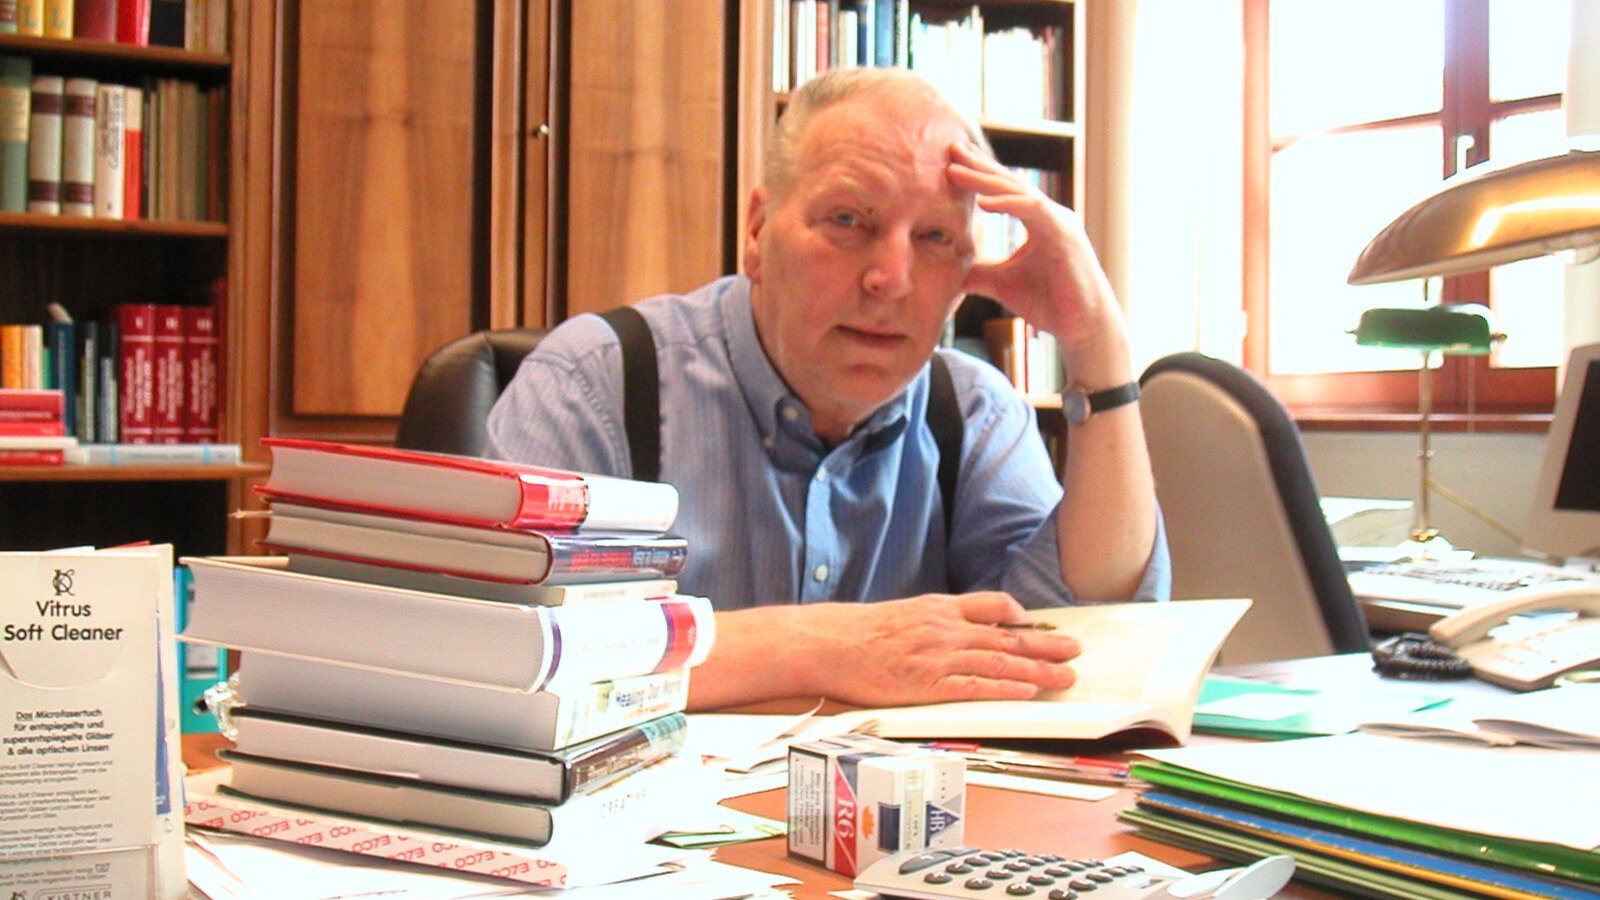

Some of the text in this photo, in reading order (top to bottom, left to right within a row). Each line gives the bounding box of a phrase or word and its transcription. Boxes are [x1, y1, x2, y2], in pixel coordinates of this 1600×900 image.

[36, 601, 91, 616] Vitrus
[4, 624, 123, 641] Soft Cleaner
[616, 687, 646, 708] Healing
[16, 709, 102, 721] Das Microfasertuch
[14, 722, 26, 732] für
[86, 720, 104, 729] und
[7, 747, 14, 756] &
[17, 745, 33, 755] alle
[81, 743, 109, 753] Linsen
[836, 799, 855, 839] R6
[352, 835, 390, 853] ELCO
[454, 850, 496, 869] ELCO
